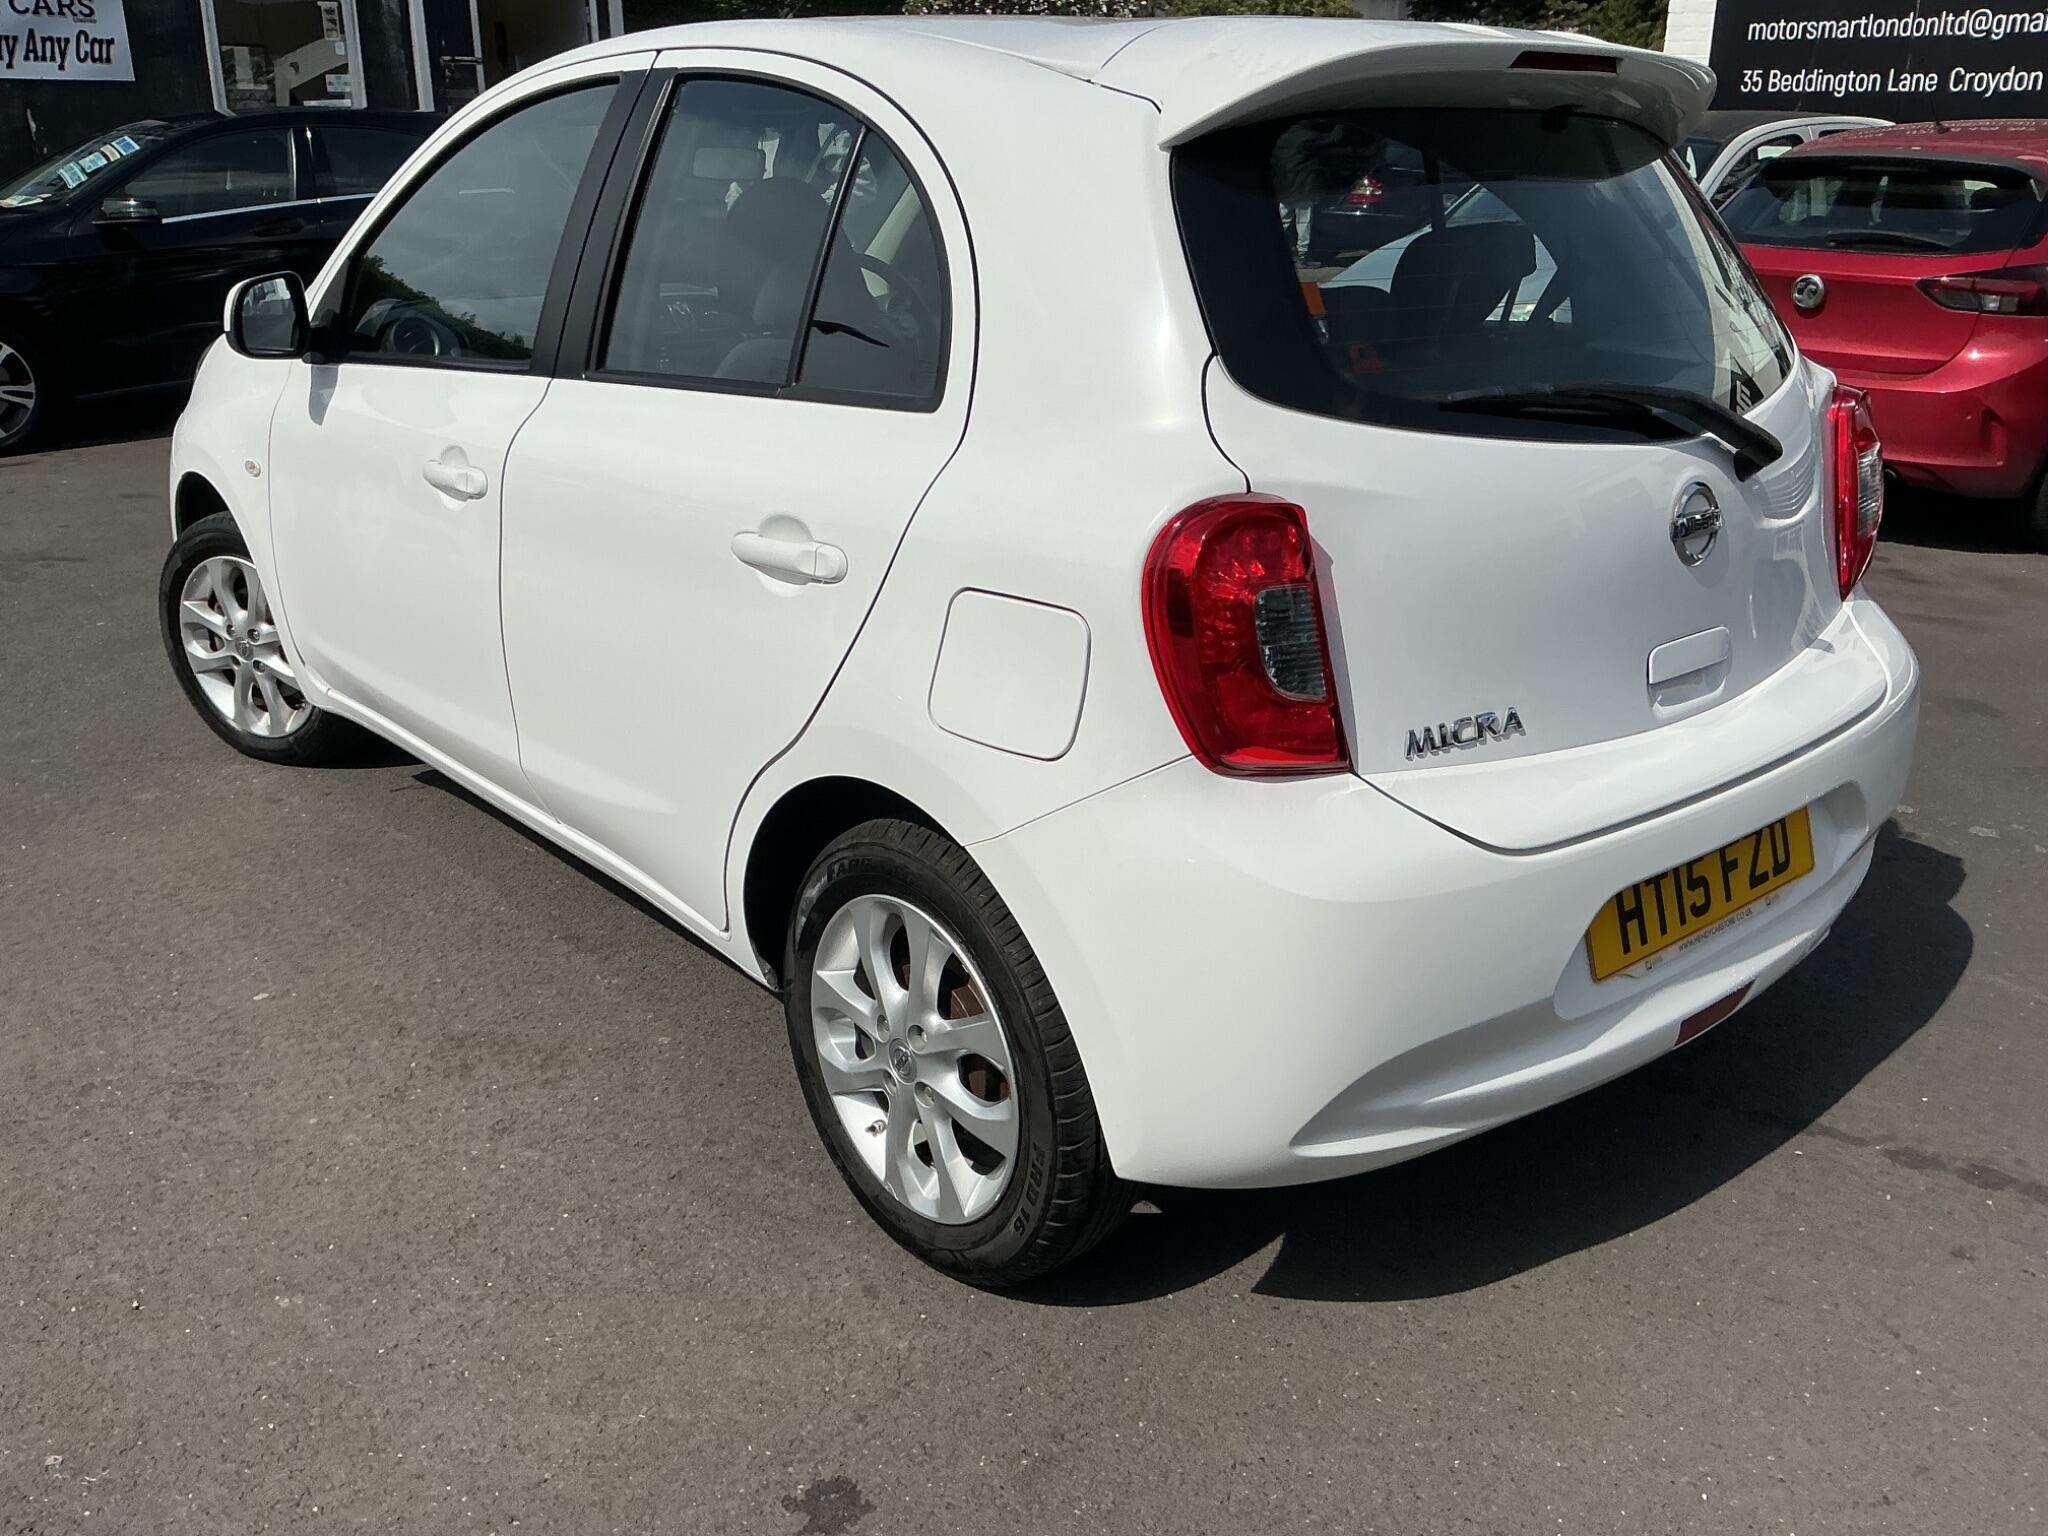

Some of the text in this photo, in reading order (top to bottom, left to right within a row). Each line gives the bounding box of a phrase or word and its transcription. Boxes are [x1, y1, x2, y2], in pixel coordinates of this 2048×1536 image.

[23, 28, 70, 71] Any
[75, 29, 115, 64] Car
[1740, 66, 2044, 97] 35 Beddington Lane Croydon
[1406, 706, 1526, 761] MICRA
